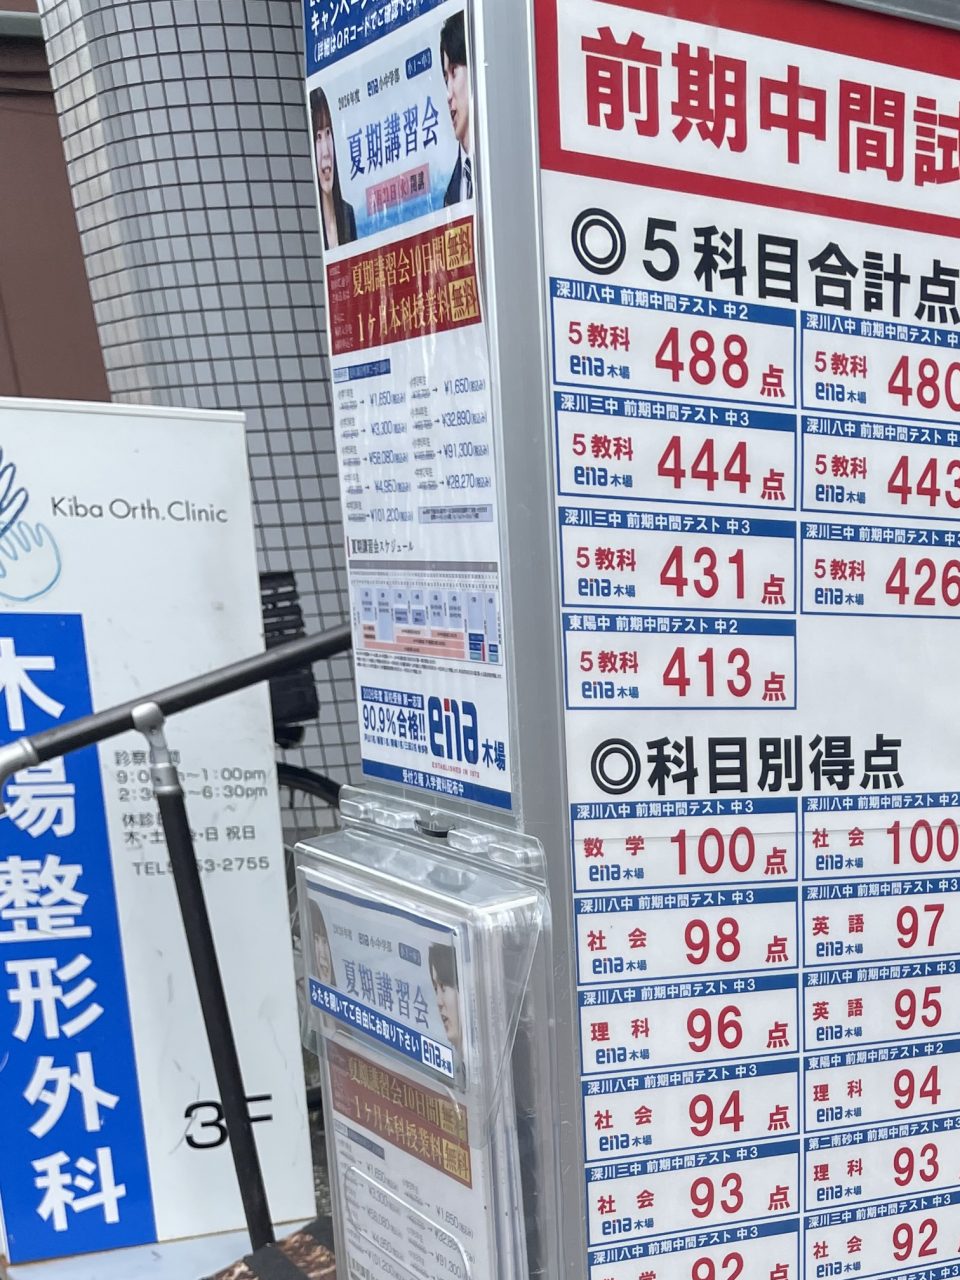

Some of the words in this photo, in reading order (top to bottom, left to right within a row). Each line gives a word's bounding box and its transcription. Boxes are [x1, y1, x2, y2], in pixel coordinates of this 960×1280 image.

[347, 96, 439, 180] 夏期講習会
[352, 233, 446, 297] 夏期講習会10日間
[447, 224, 471, 268] 無料
[451, 278, 478, 319] 無料
[556, 280, 615, 304] 深川八中
[621, 289, 717, 316] 前期中間テスト
[723, 303, 748, 320] 中2
[568, 321, 630, 352] 5教科
[50, 497, 103, 518] Kiba
[569, 614, 610, 631] 東陽中
[616, 617, 708, 633] 前期中間テスト
[715, 619, 738, 634] 中2
[363, 704, 426, 741] 90.9%合格!!
[428, 696, 478, 765] ena
[482, 739, 506, 771] 木場
[577, 803, 629, 819] 深川八中
[636, 801, 726, 817] 前期中間テスト
[731, 799, 754, 815] 中3
[226, 825, 255, 840] 祝日
[342, 959, 429, 1028] 夏期講習会
[312, 985, 419, 1052] ふたを開いてご自由にお取り下さい
[808, 1053, 842, 1070] 東陽中
[845, 1044, 919, 1065] 前期中間テスト
[925, 1040, 944, 1055] 中2
